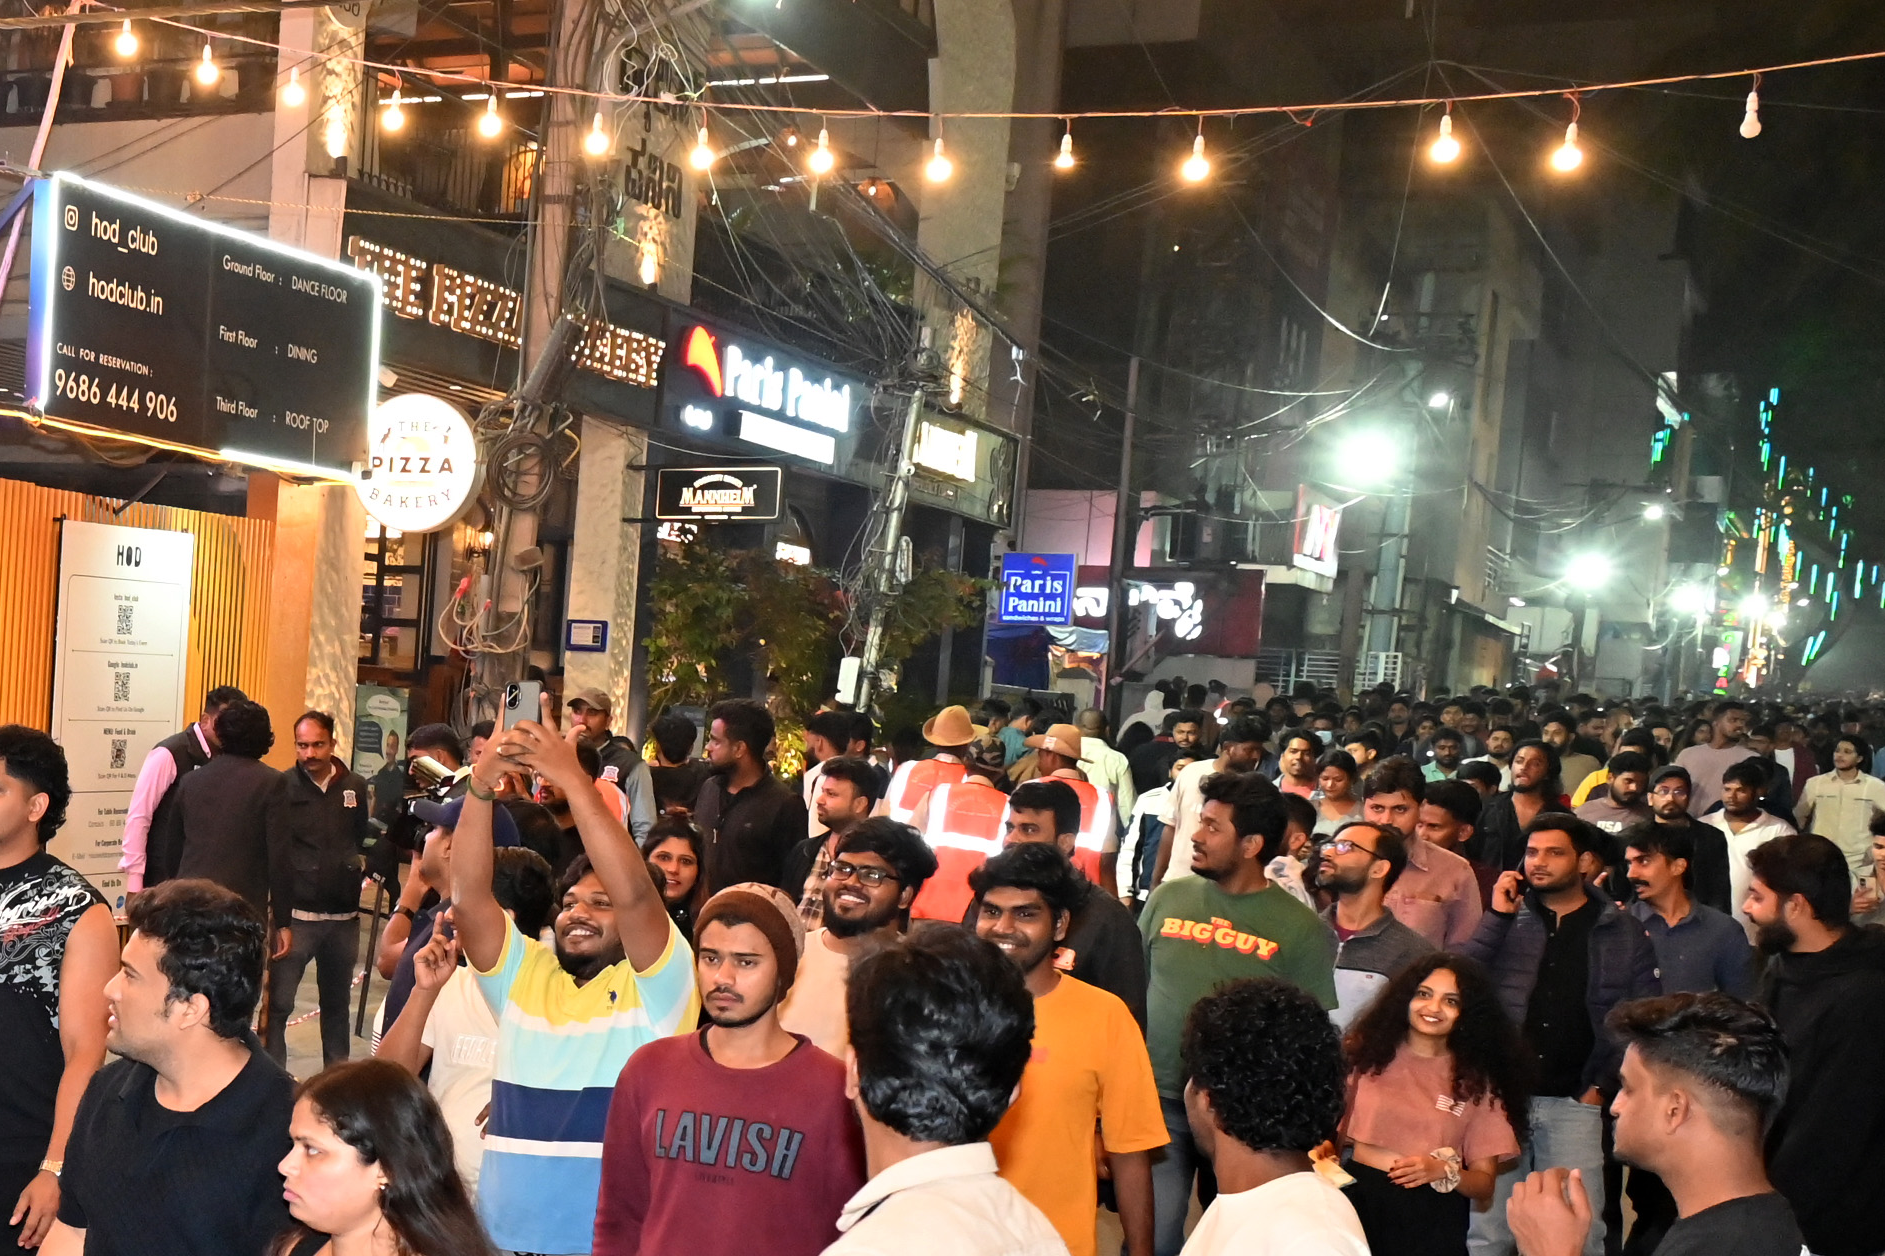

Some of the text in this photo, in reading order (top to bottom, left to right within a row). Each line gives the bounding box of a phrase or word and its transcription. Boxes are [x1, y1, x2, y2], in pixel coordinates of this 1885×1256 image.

[91, 211, 158, 256] hod_club
[88, 270, 163, 315] hodclub.in
[223, 254, 253, 277] Ground
[255, 264, 275, 283] Floor
[291, 275, 319, 296] DANCE
[321, 284, 347, 304] FLOOR
[56, 342, 76, 358] CALL
[79, 348, 95, 362] FOR
[219, 324, 236, 343] First
[238, 330, 258, 349] Floor
[287, 343, 318, 364] DINING
[55, 368, 177, 423] 9686 444 906
[724, 344, 784, 411] Paris
[216, 395, 236, 414] Third
[238, 401, 258, 418] Floor
[285, 410, 310, 430] ROOF
[312, 417, 329, 434] TOP
[398, 421, 431, 432] THE
[372, 456, 453, 474] PIZZA
[369, 487, 451, 509] BAKERY
[680, 486, 755, 505] MANNHEIM
[117, 544, 142, 567] HOD
[1009, 576, 1063, 593] Paris
[1008, 597, 1062, 613] Panini
[1160, 917, 1279, 960] BIG GUY
[655, 1108, 805, 1181] LAVISH
